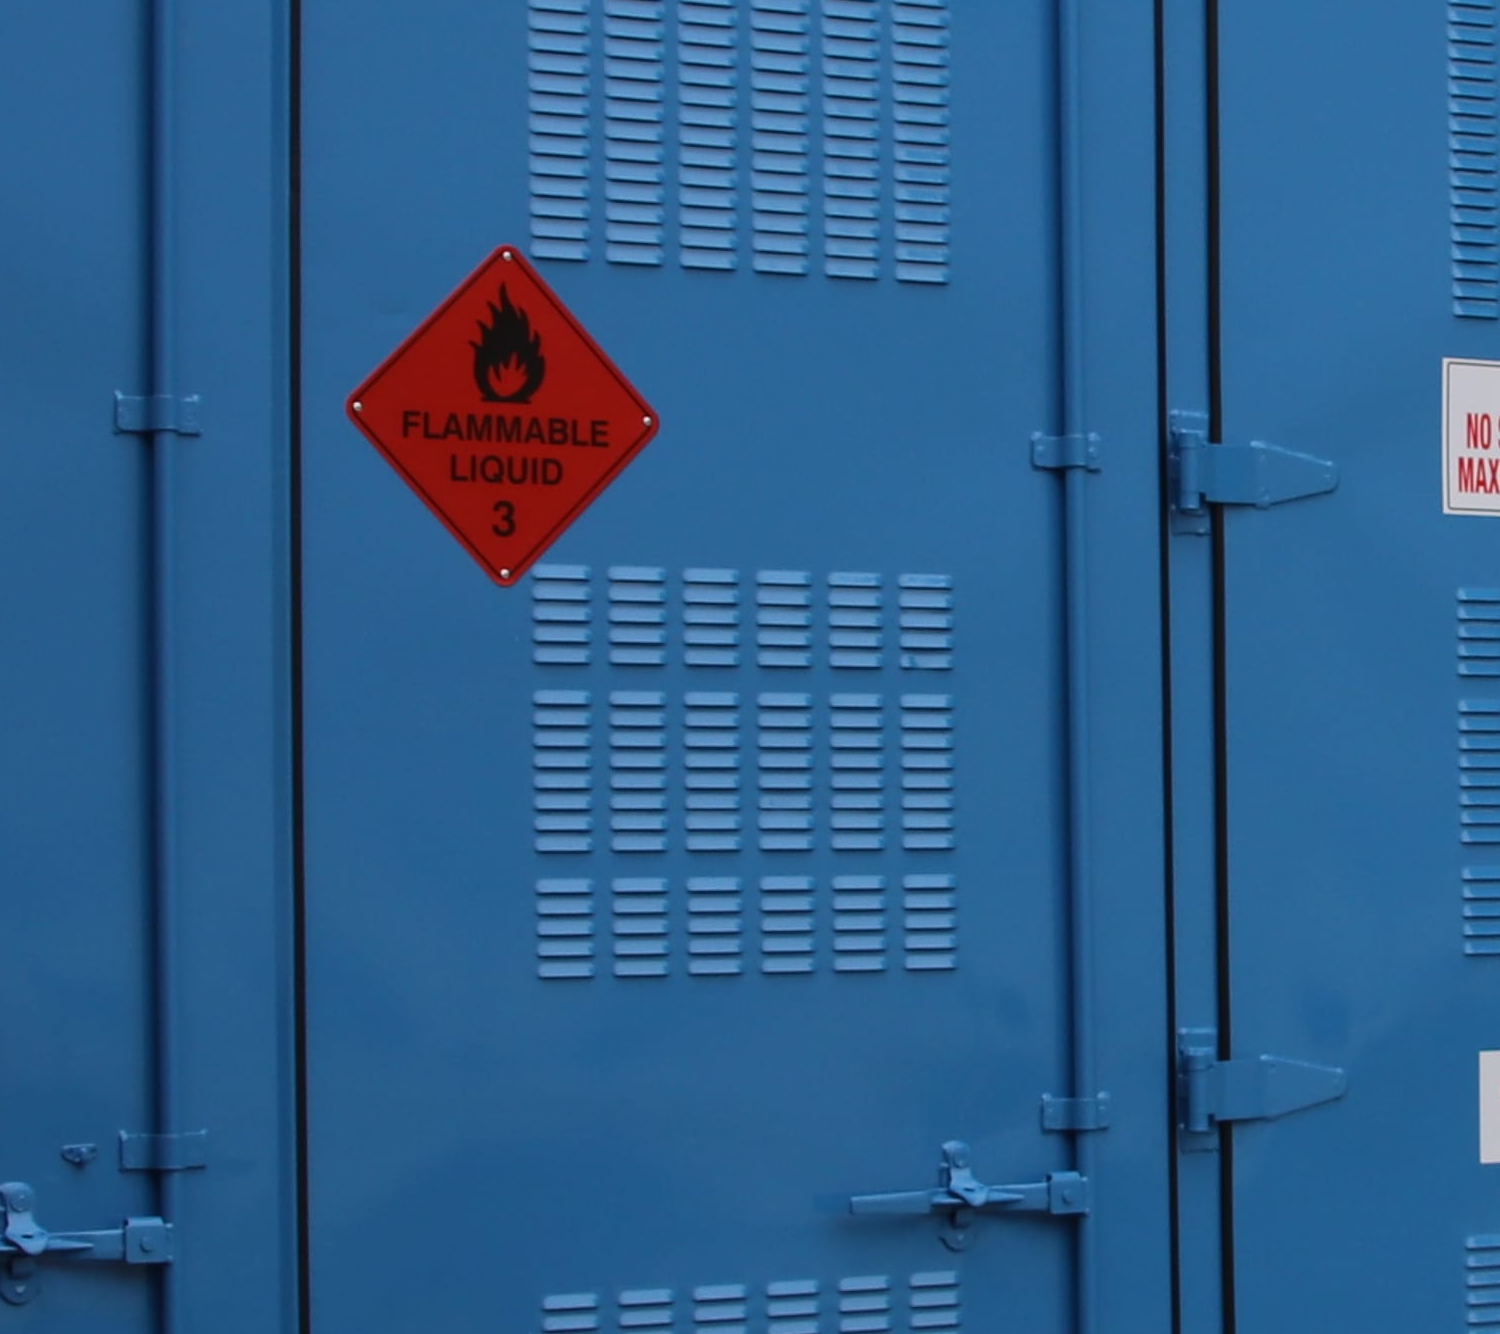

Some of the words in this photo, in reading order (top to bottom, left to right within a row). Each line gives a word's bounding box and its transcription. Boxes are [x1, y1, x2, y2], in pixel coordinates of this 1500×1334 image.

[403, 411, 610, 447] FLAMMABLE
[1467, 413, 1491, 450] NO
[450, 455, 563, 485] LIQUID
[492, 501, 516, 537] 3
